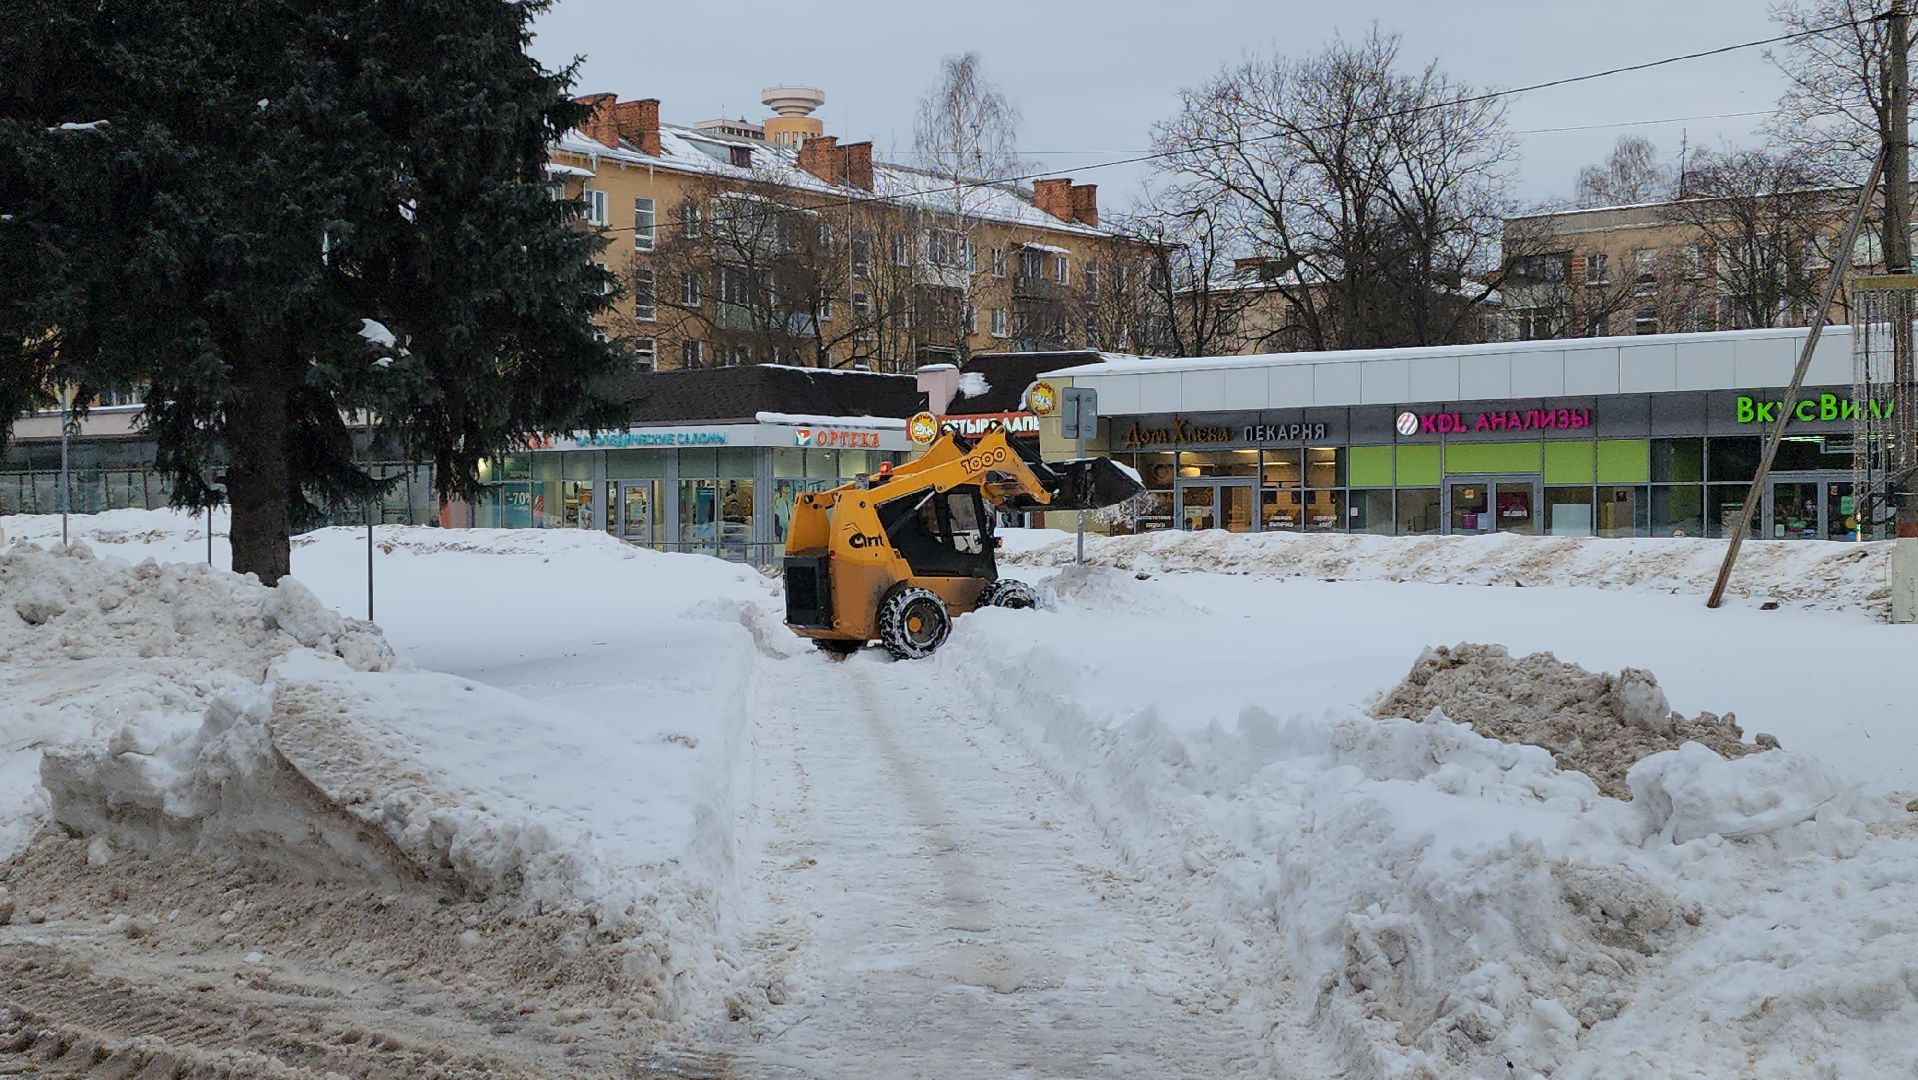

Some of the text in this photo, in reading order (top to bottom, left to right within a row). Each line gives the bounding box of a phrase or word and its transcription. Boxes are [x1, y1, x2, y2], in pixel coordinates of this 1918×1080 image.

[1420, 409, 1590, 433] KDL АНАЛИЗЫ
[817, 431, 880, 448] ОРТЕКА
[1243, 423, 1326, 441] ПЕКАРНЯ
[961, 447, 1006, 475] 1000
